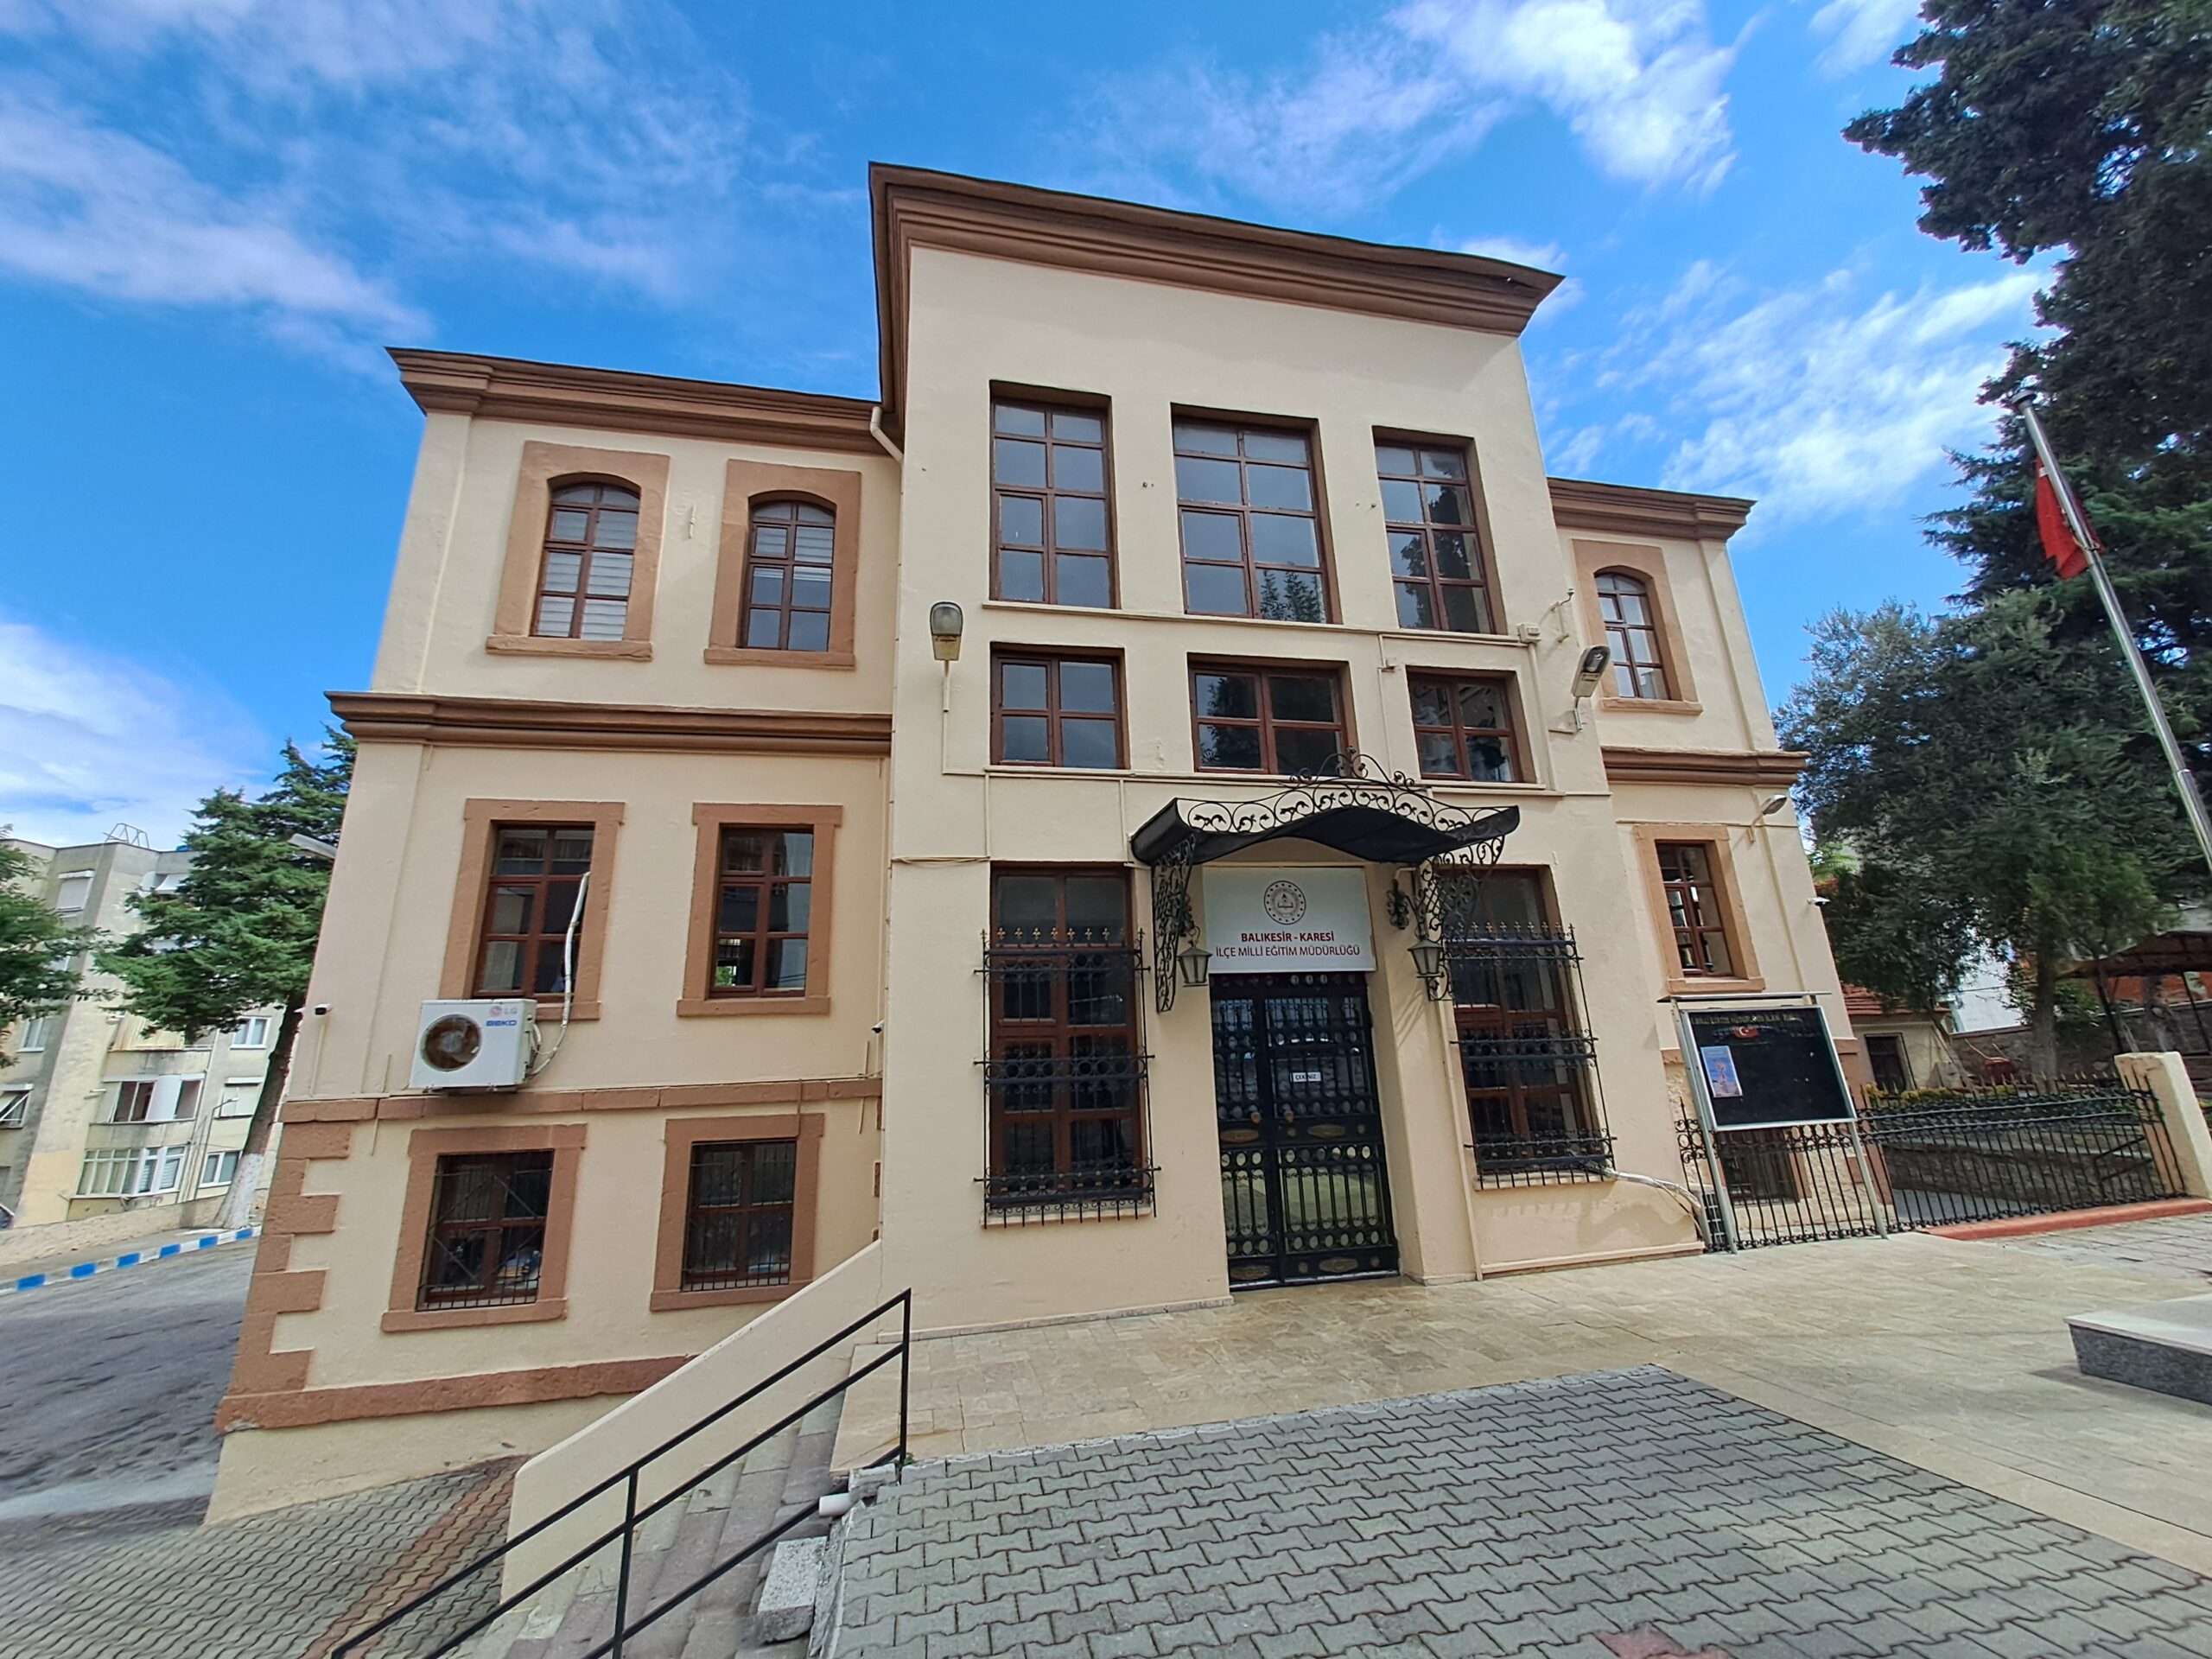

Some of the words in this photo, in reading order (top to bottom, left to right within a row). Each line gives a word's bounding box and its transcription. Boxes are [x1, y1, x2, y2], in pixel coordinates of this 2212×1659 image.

[1241, 931, 1292, 942] BALIKESİR
[1299, 931, 1334, 942] KARESİ
[1216, 945, 1236, 958] İLÇE
[1238, 945, 1263, 957] MİLLİ
[1266, 944, 1298, 956] EĞİTİM
[1300, 944, 1360, 956] MÜDÜRLÜĞÜ
